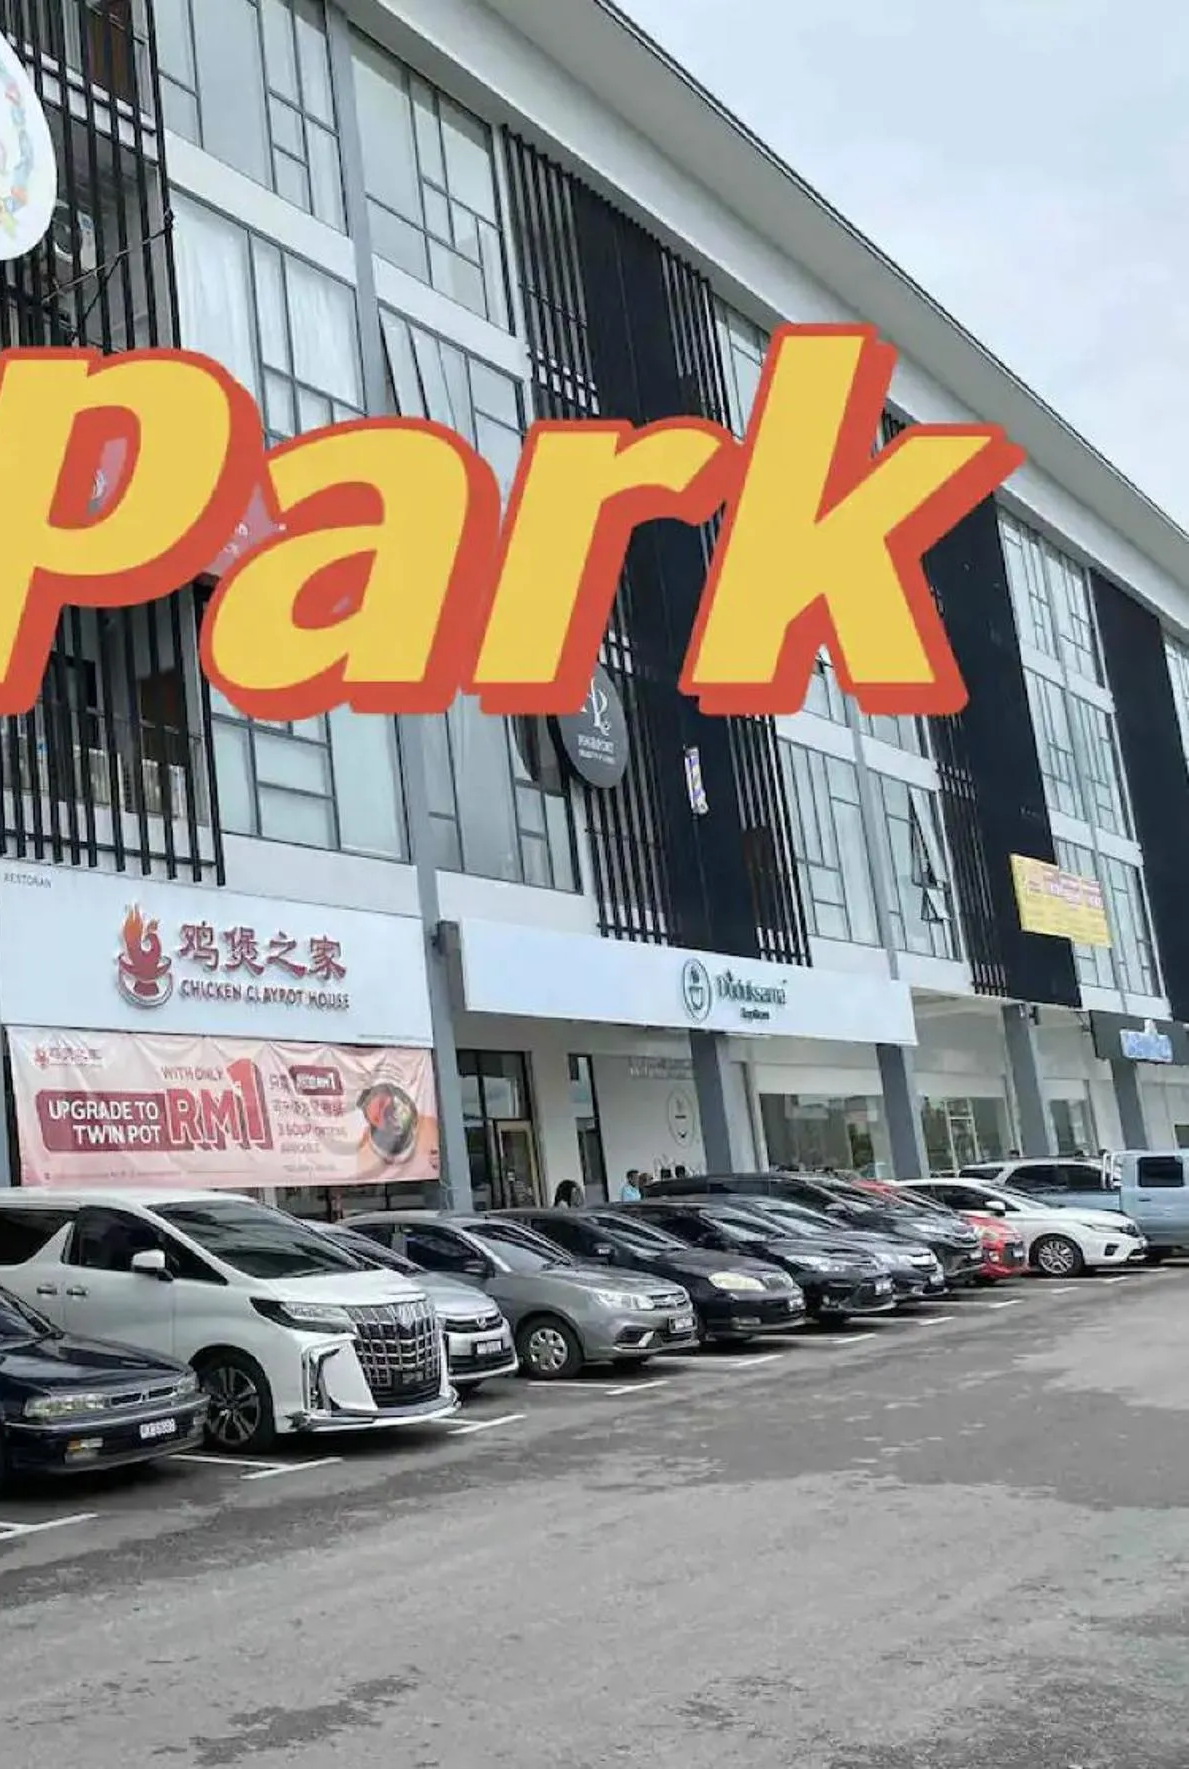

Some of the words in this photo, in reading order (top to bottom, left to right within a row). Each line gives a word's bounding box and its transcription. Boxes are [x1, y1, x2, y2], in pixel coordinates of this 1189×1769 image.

[178, 920, 347, 981] 鸡煲之家
[180, 980, 242, 1000] CHICKEN
[246, 985, 303, 1007] CLAYPOT
[308, 991, 350, 1012] HOUSE
[48, 1099, 133, 1121] UPGRADE
[134, 1101, 159, 1121] TO
[73, 1125, 125, 1145] TWIN
[127, 1125, 162, 1145] POT
